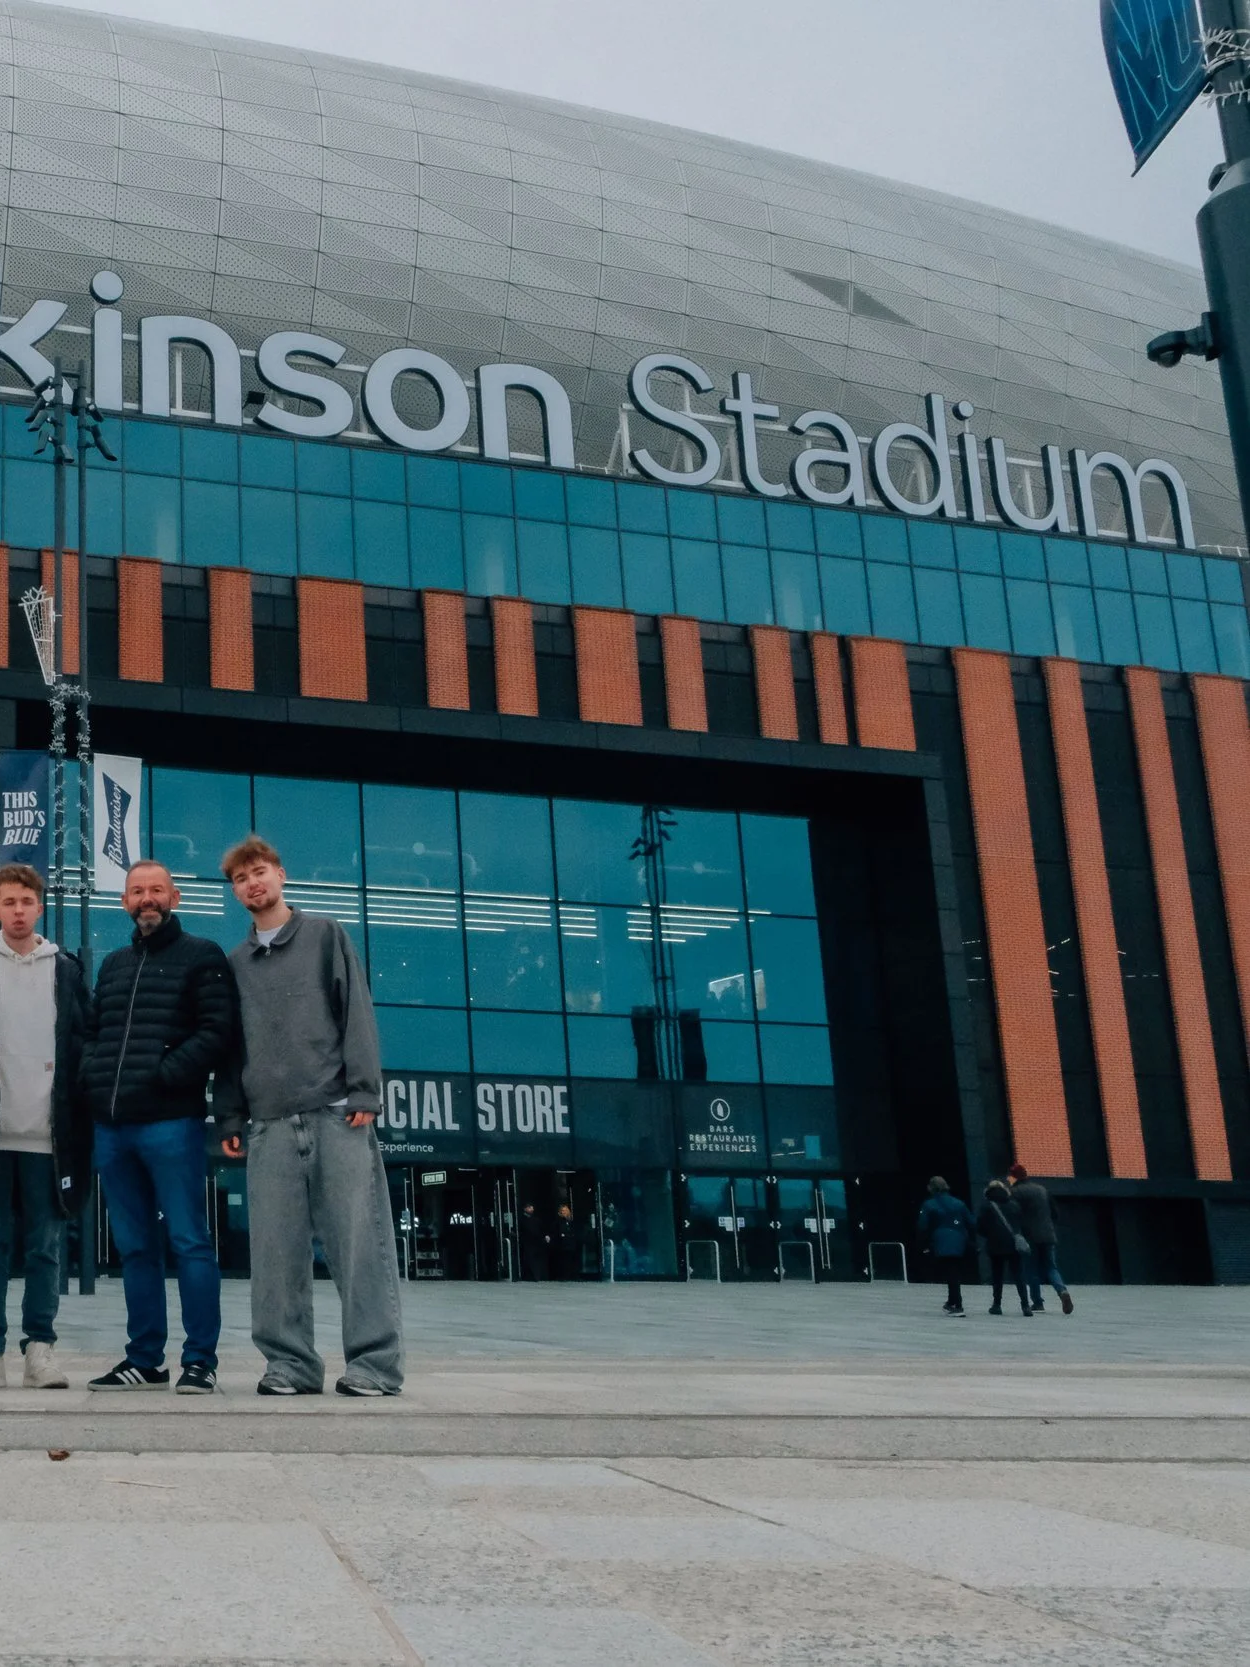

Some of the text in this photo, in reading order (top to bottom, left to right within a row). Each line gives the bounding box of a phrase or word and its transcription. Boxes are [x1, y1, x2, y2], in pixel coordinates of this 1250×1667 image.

[628, 353, 1197, 549] Stadium
[2, 791, 38, 810] THIS
[3, 809, 46, 828] BUD'S
[107, 783, 123, 867] Budweiser
[2, 828, 42, 846] BLUE
[476, 1082, 570, 1134] STORE
[709, 1125, 735, 1133] BARS
[377, 1141, 435, 1154] Experience
[689, 1134, 756, 1143] RESTAURANTS
[690, 1143, 757, 1153] EXPERIENCES
